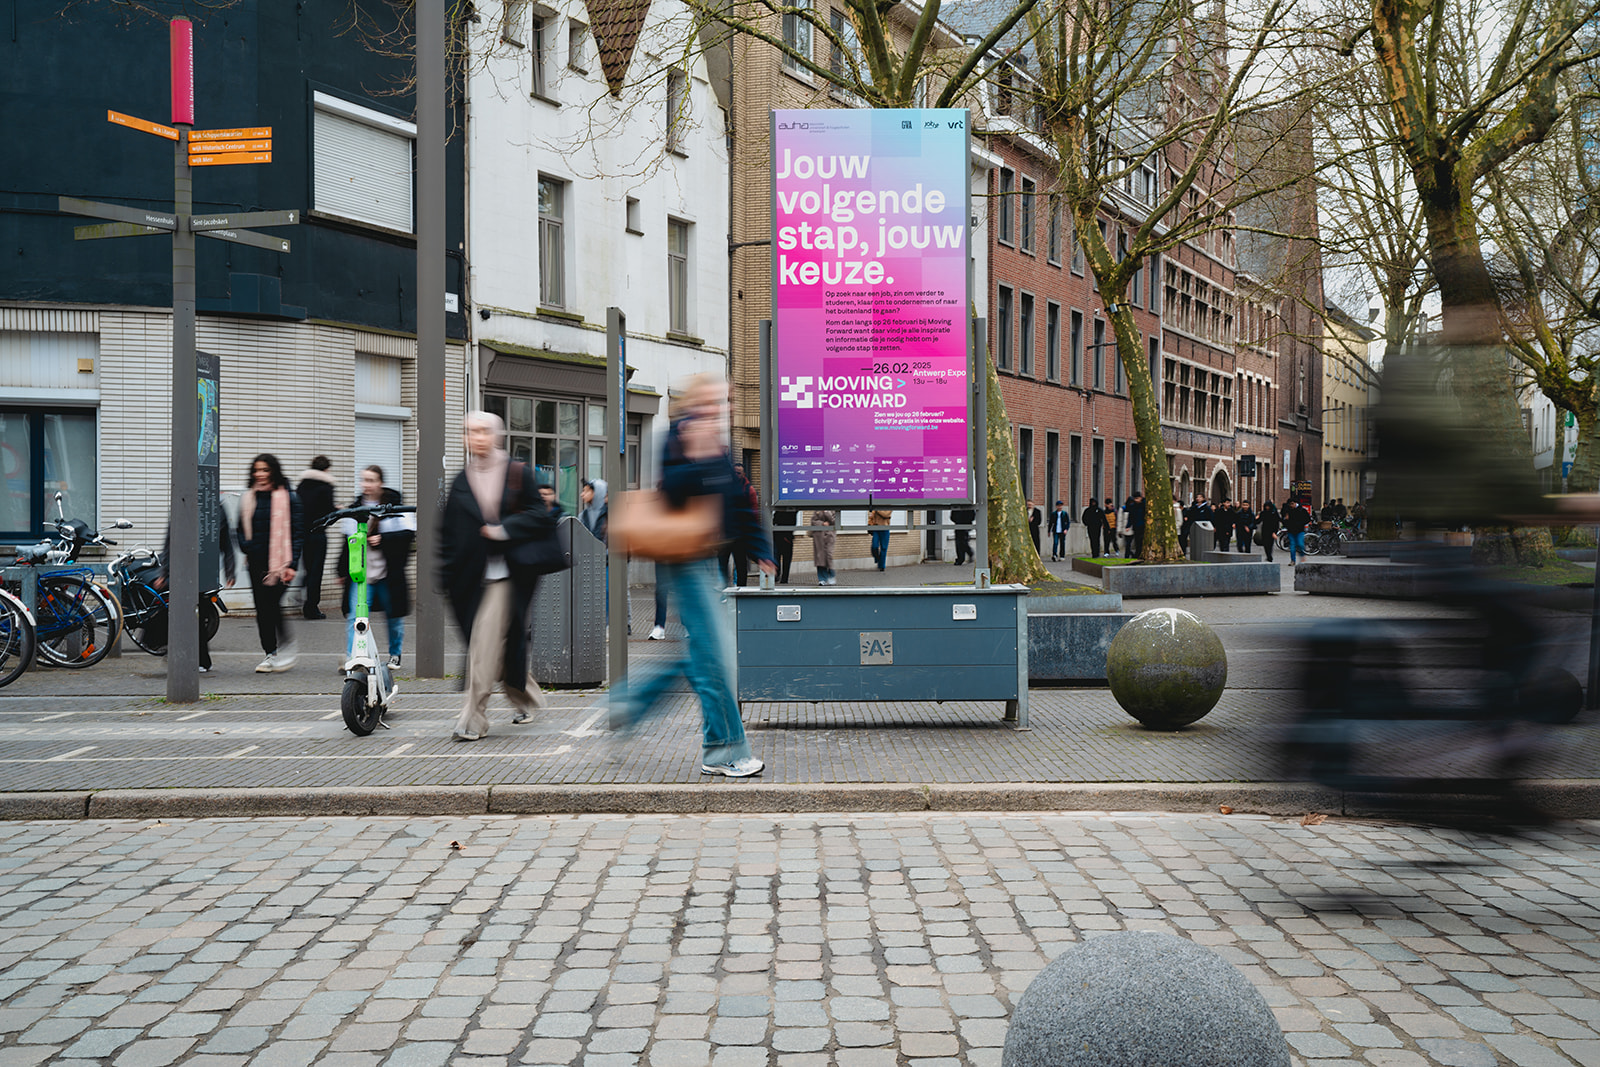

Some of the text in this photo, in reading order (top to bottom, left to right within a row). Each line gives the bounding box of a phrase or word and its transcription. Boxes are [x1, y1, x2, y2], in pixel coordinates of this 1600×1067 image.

[948, 120, 964, 128] vrt
[776, 149, 870, 179] Jouw
[778, 183, 945, 223] volgende
[145, 215, 175, 225] Hessenhuis
[778, 218, 964, 258] stap, jouw
[780, 255, 894, 285] keuze.
[880, 290, 893, 298] job,
[913, 369, 967, 377] Antwerp Expo
[818, 376, 893, 391] MOVING
[818, 394, 907, 408] FORWARD
[868, 640, 885, 656] A
